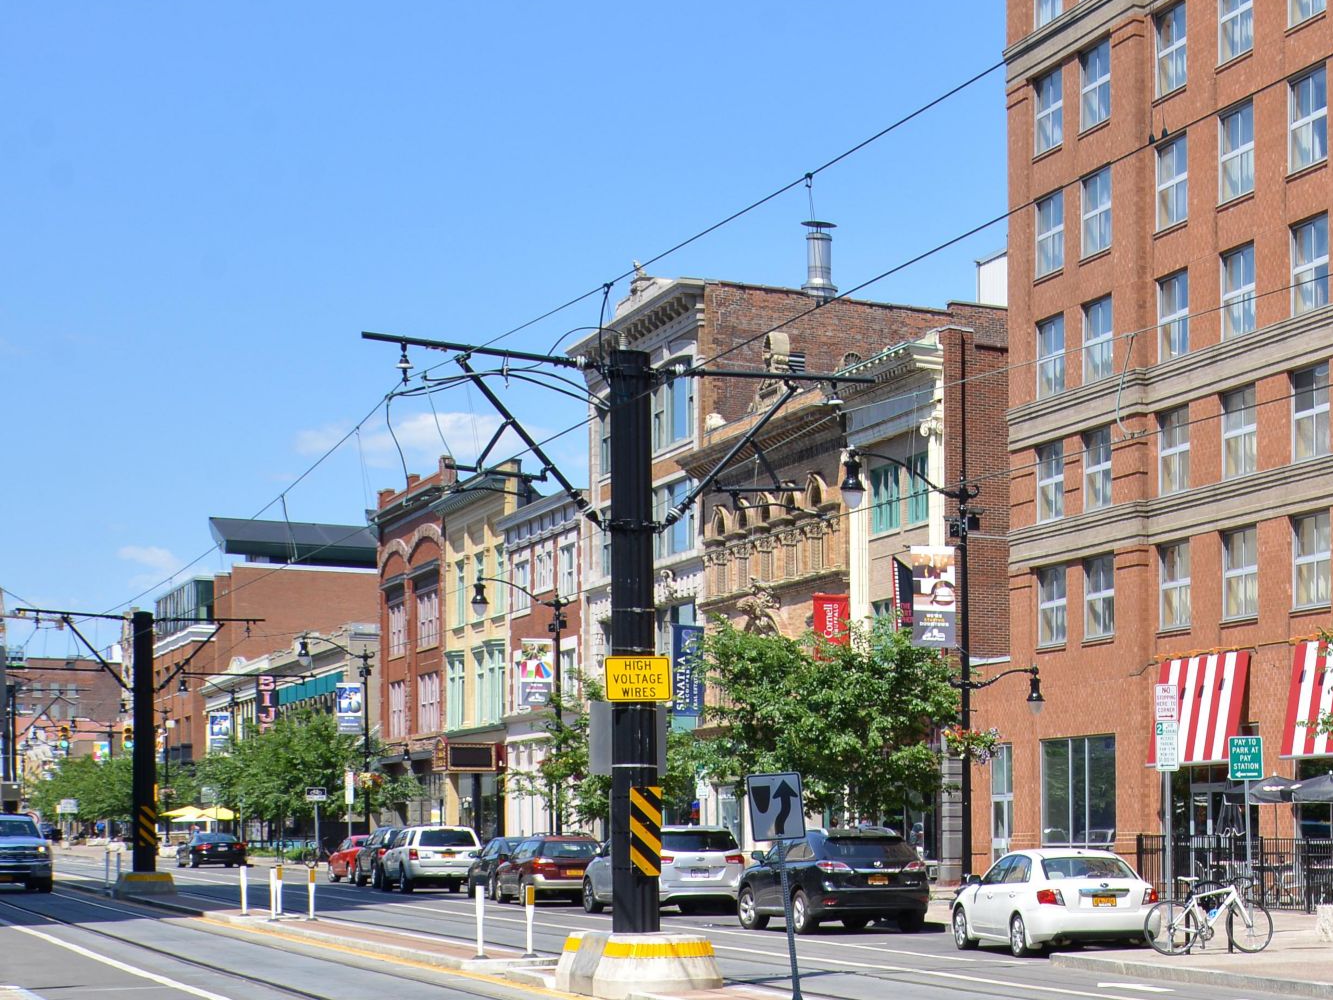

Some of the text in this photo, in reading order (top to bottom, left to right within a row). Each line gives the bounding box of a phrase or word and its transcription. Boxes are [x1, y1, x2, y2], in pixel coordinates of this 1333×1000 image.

[824, 604, 833, 639] Cornell
[624, 660, 651, 670] HIGH
[613, 674, 663, 684] VOLTAGE
[621, 687, 656, 697] WIRES
[1157, 724, 1163, 734] 2
